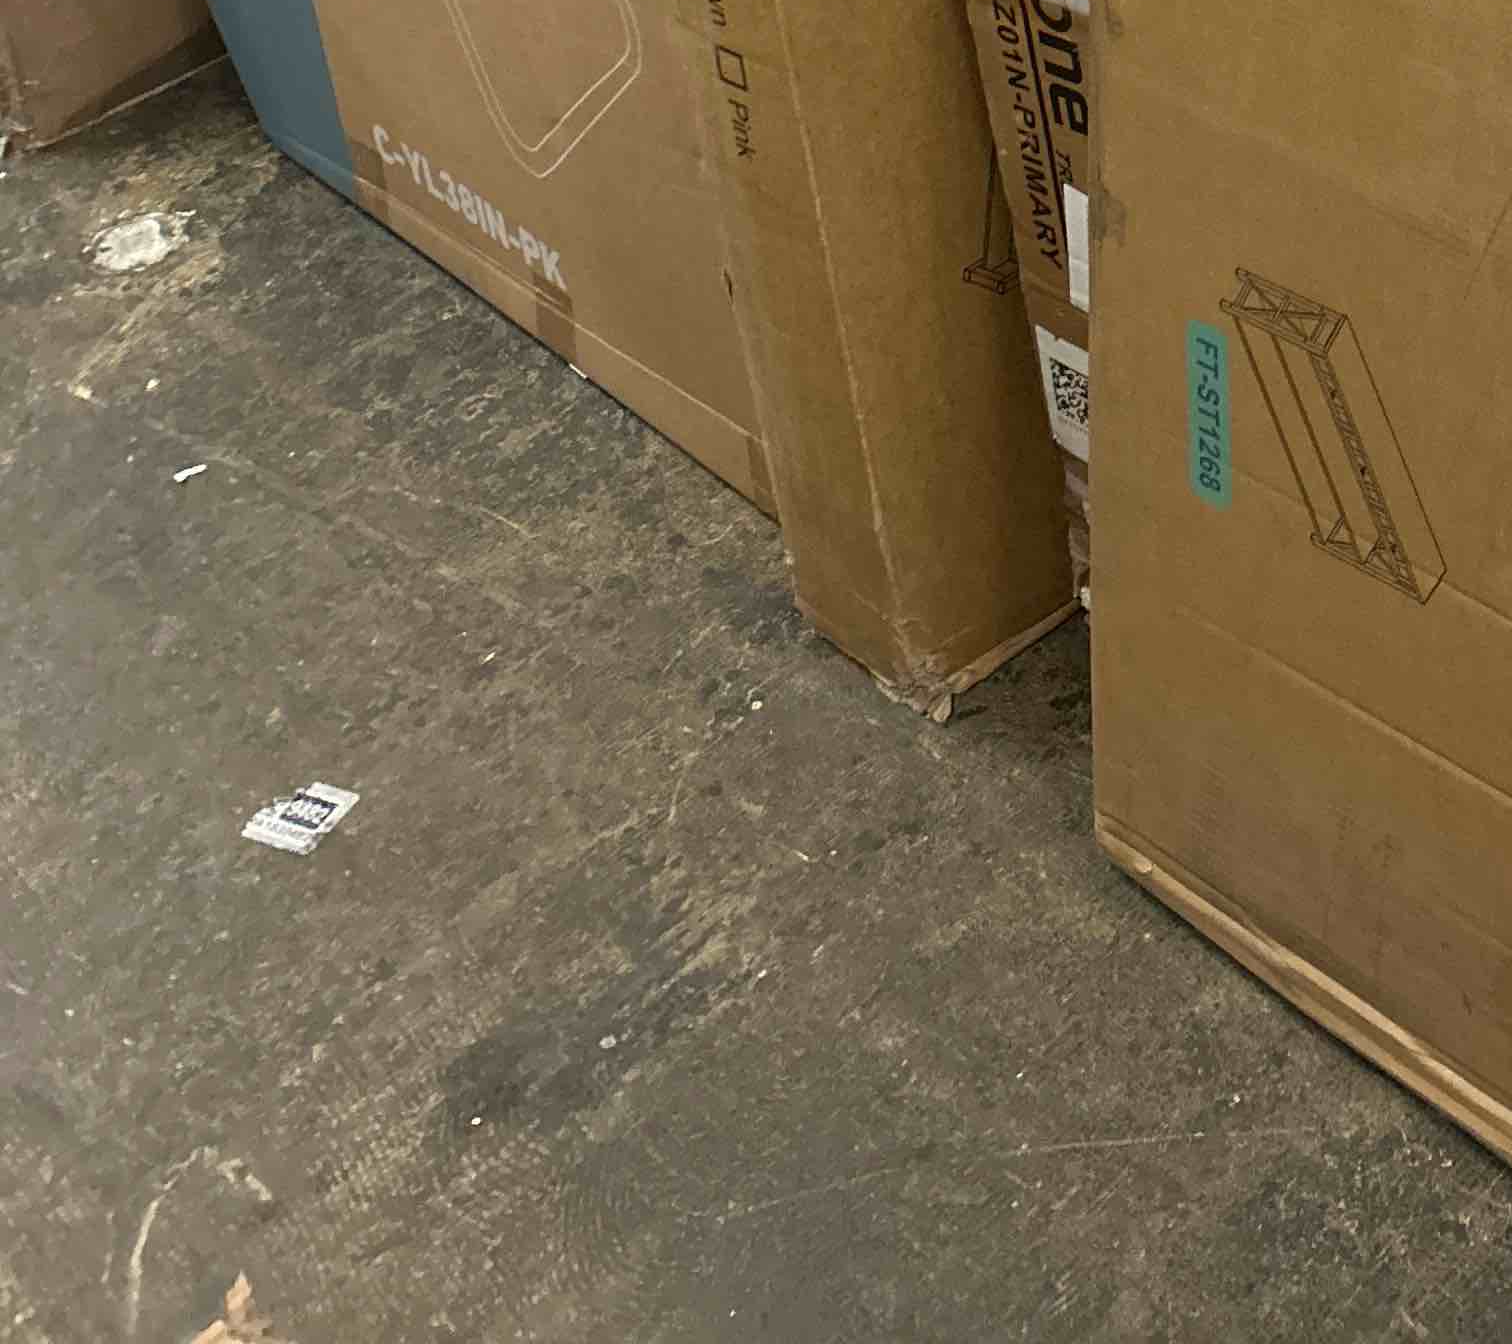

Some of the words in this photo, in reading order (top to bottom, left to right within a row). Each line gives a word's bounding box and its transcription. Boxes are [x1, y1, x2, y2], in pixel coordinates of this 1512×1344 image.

[372, 123, 567, 290] C-YL38IN-PK
[727, 100, 754, 159] Pink
[1196, 337, 1223, 492] FT-ST1268
